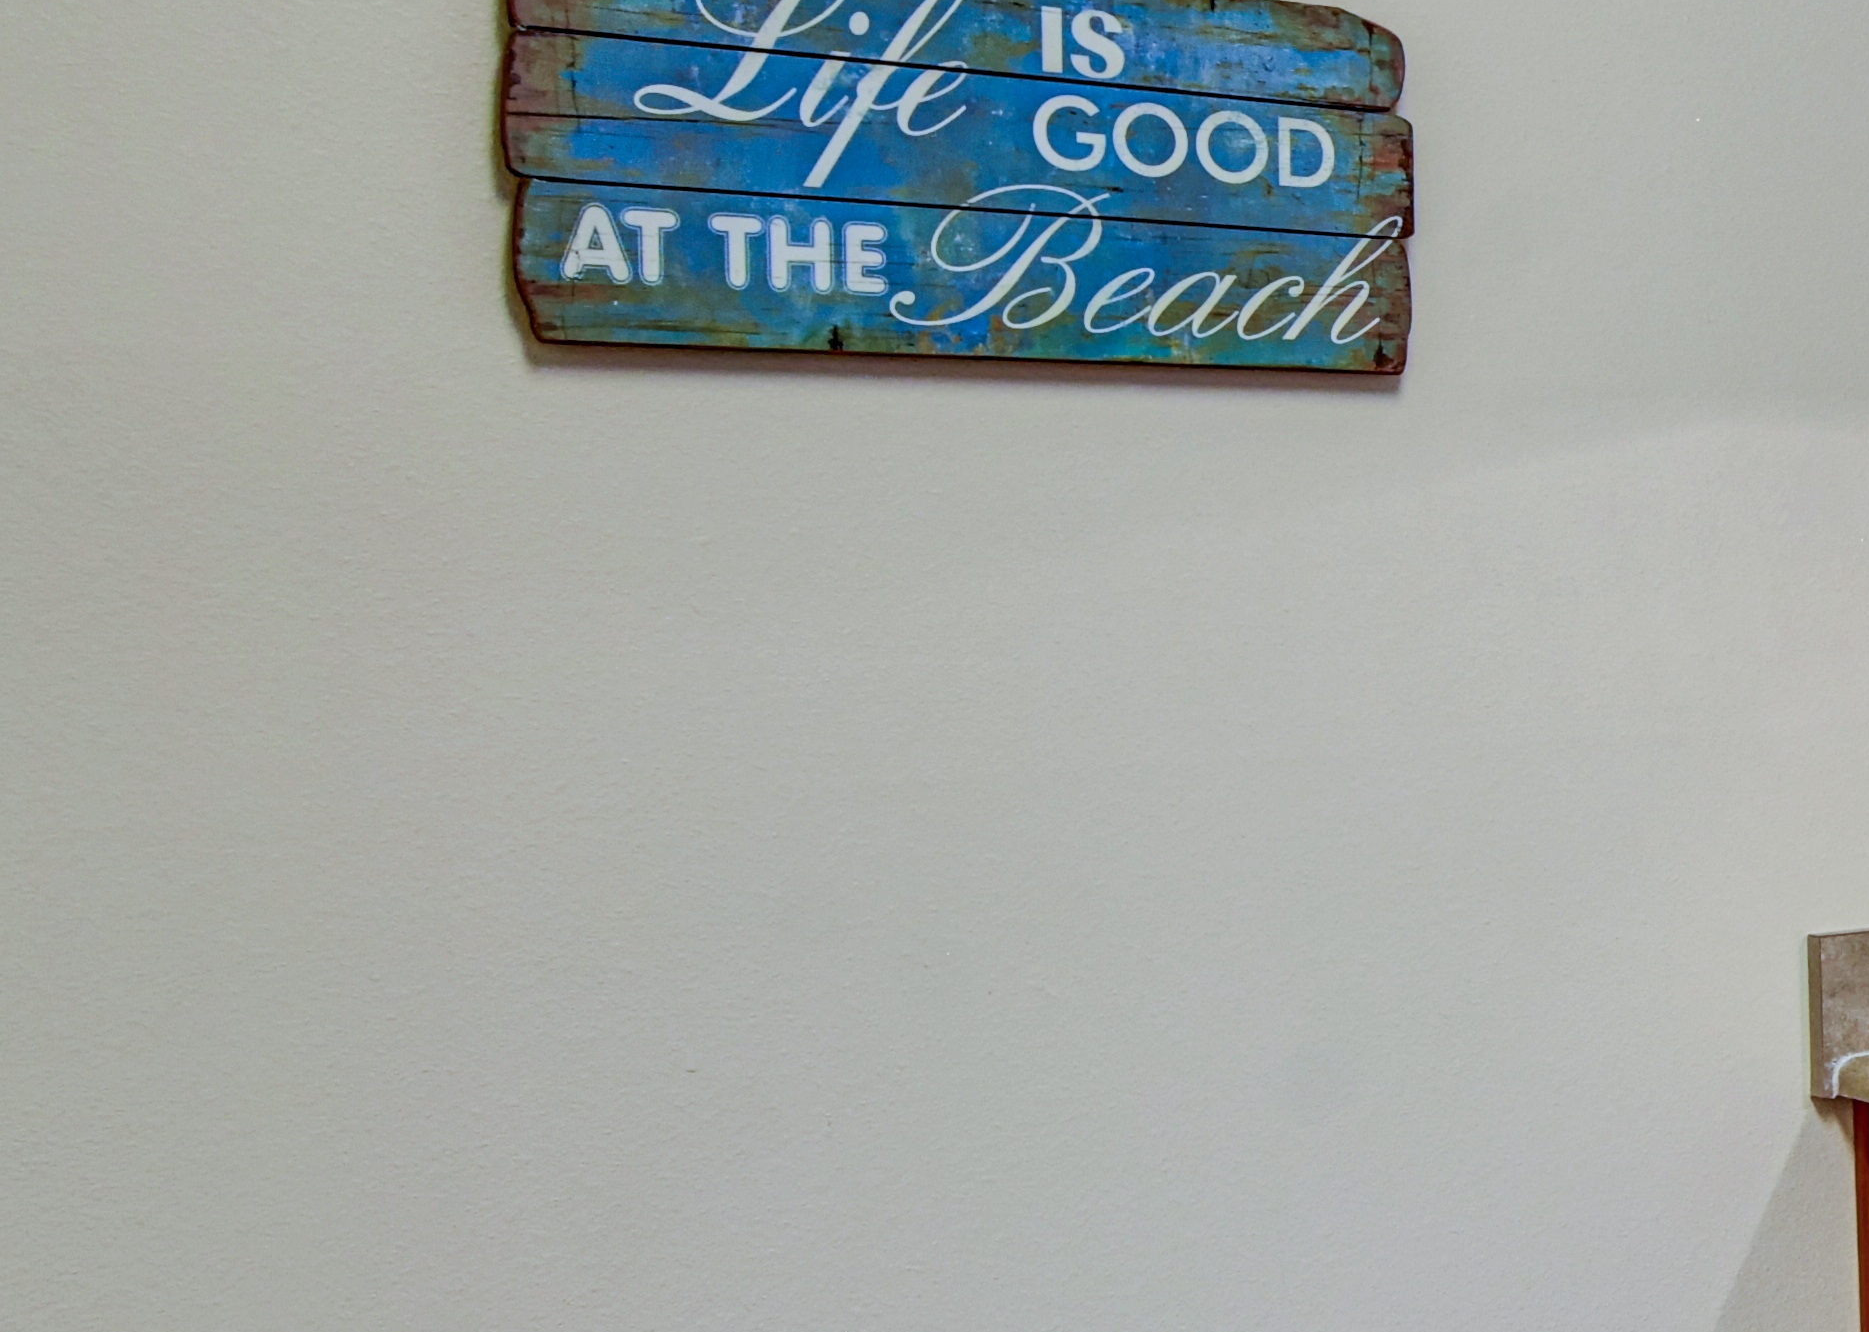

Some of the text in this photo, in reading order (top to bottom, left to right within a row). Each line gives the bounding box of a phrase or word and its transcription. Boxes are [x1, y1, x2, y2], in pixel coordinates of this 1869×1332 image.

[1041, 5, 1125, 79] IS
[1032, 95, 1335, 189] GOOD
[560, 184, 1403, 345] AT THE Beach
